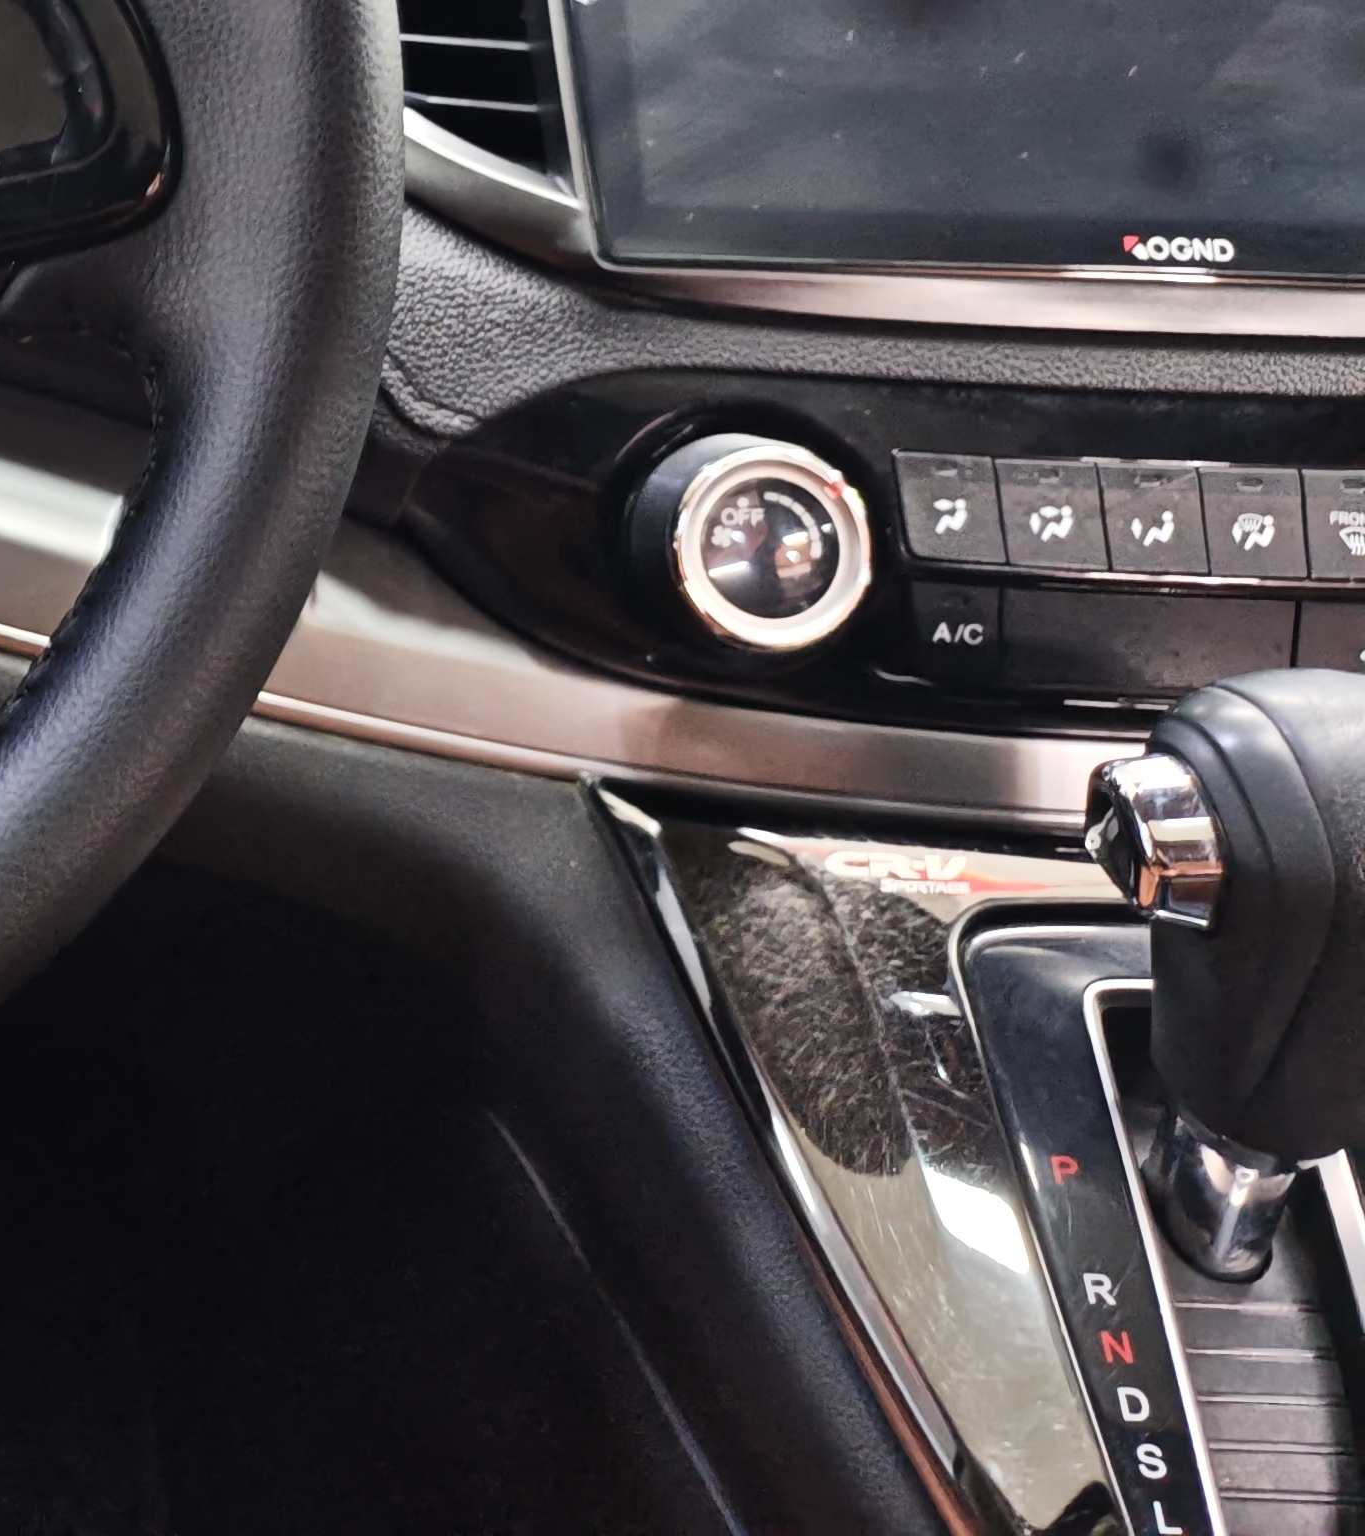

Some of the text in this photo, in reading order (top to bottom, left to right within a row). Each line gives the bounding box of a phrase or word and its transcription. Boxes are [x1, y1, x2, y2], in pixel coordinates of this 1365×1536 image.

[721, 507, 765, 528] OFF
[932, 621, 984, 647] A/C
[1049, 1154, 1080, 1185] P
[1082, 1272, 1117, 1306] R
[1099, 1330, 1135, 1364] N
[1116, 1386, 1151, 1422] D
[1136, 1443, 1168, 1480] S
[1152, 1500, 1184, 1535] L
